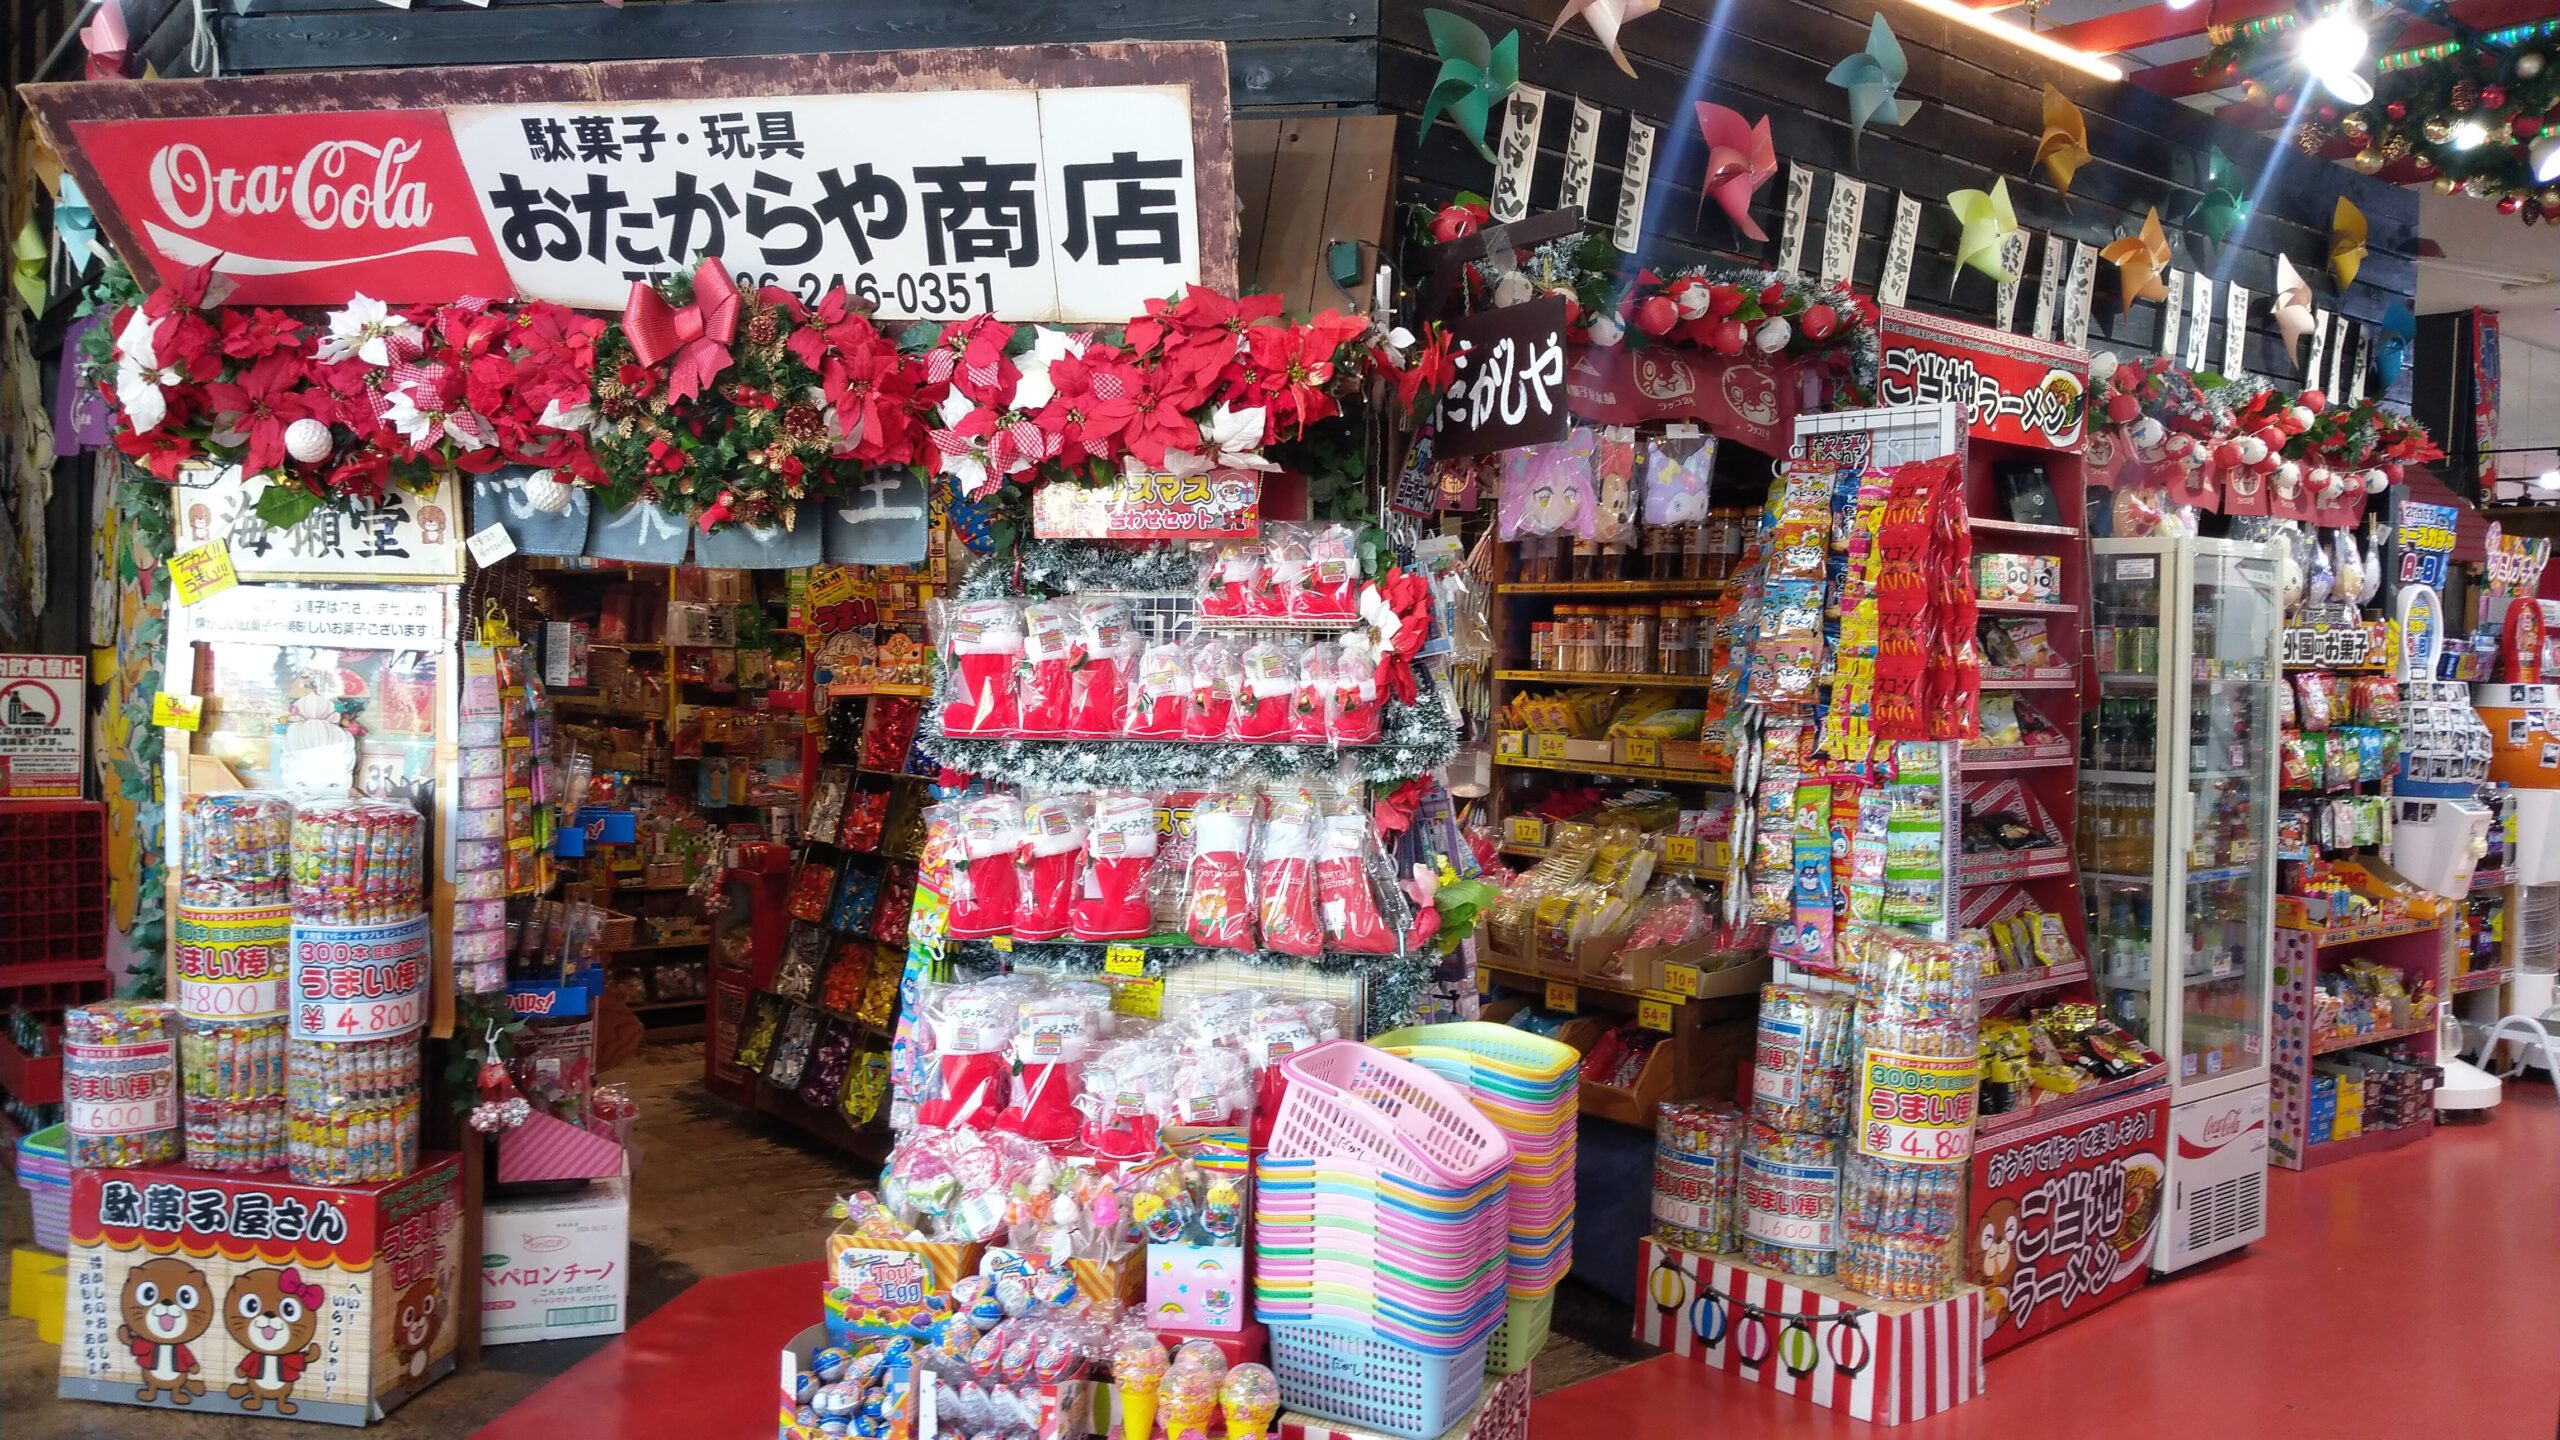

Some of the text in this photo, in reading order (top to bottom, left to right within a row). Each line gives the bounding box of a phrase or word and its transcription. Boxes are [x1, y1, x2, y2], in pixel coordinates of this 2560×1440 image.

[522, 111, 804, 164] 駄菓子・玩具
[488, 151, 1184, 268] おたからや商店
[1880, 543, 1920, 560] スコーン
[2401, 553, 2417, 581] A
[2421, 556, 2437, 584] B
[2283, 628, 2370, 668] 外国のお菓子
[1541, 739, 1564, 752] 54円
[1630, 744, 1654, 758] 17円
[1518, 824, 1539, 837] 17円
[1670, 843, 1694, 856] 17円
[299, 942, 369, 965] 300本
[300, 957, 417, 1001] うまい棒
[1666, 970, 1697, 988] 510円
[1642, 1008, 1668, 1022] 54円
[1871, 1065, 1936, 1090] 300本
[1870, 1087, 1973, 1125] うまい棒
[101, 1180, 347, 1245] 駄菓子屋さん
[1744, 1186, 1820, 1218] うまい棒
[2015, 1159, 2127, 1263] ご当地
[482, 1260, 615, 1287] ペペロンチーノ
[870, 1257, 921, 1286] Toy's
[880, 1281, 921, 1305] Egg
[2008, 1245, 2120, 1329] ラーメン
[324, 1295, 347, 1399] いらっしゃい!
